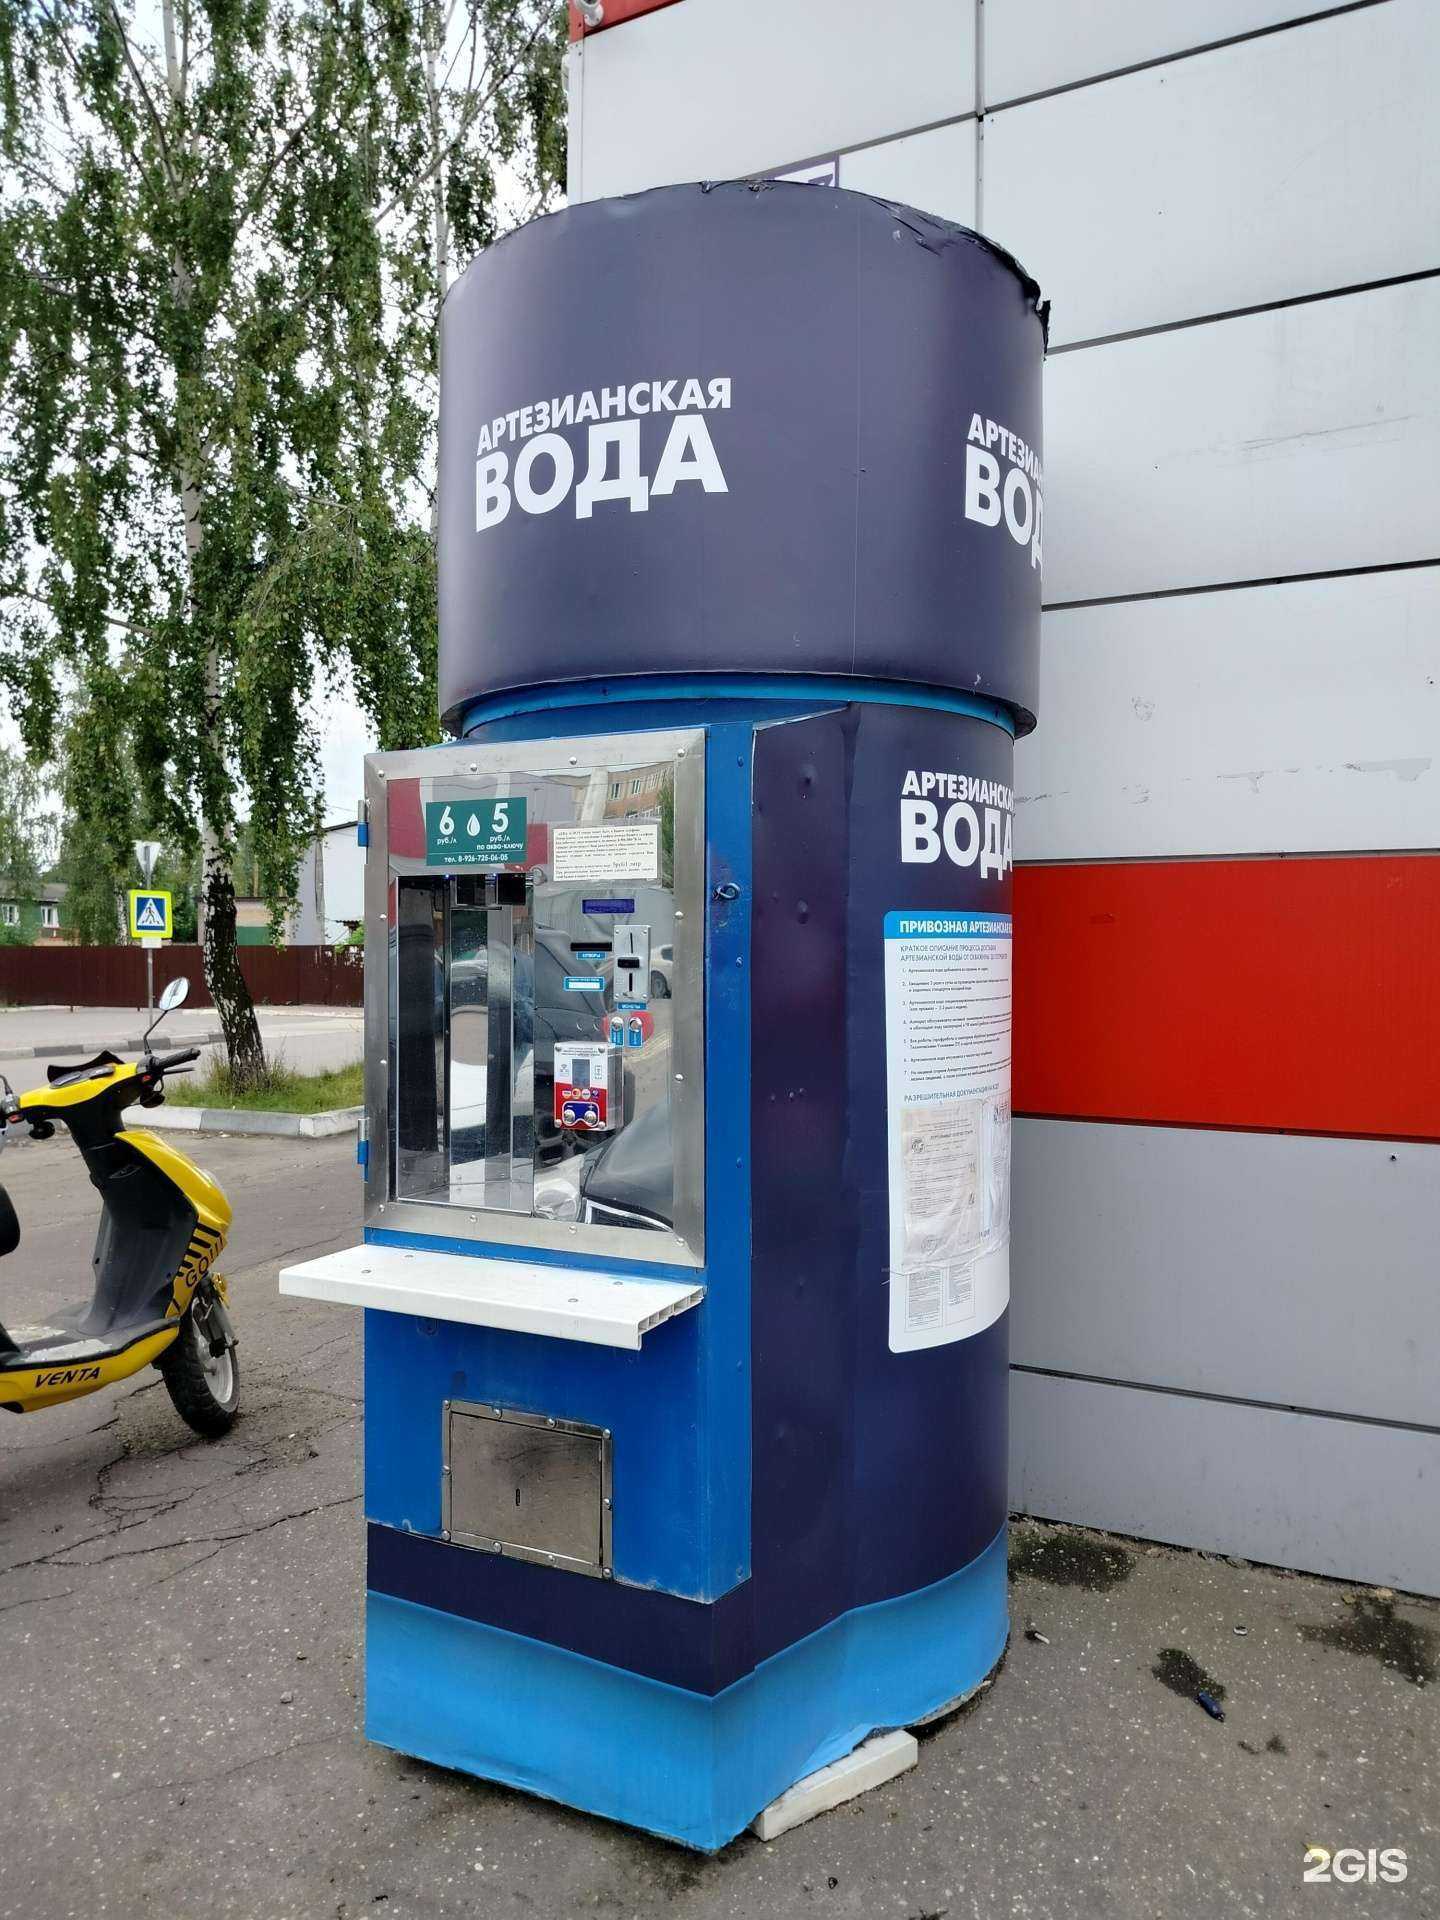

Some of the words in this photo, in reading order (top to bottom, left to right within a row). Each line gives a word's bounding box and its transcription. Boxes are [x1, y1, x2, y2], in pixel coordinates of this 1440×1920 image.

[477, 377, 731, 455] АРТЕЗИАНСКАЯ
[476, 415, 729, 532] ВОДА
[440, 805, 455, 835] 6
[492, 802, 509, 833] 5
[900, 920, 967, 933] ПРИВОЗНАЯ
[900, 944, 928, 953] КРАТКОЕ
[900, 953, 948, 962] АРТЕЗИАНСКОЙ
[35, 1367, 100, 1388] VENTA
